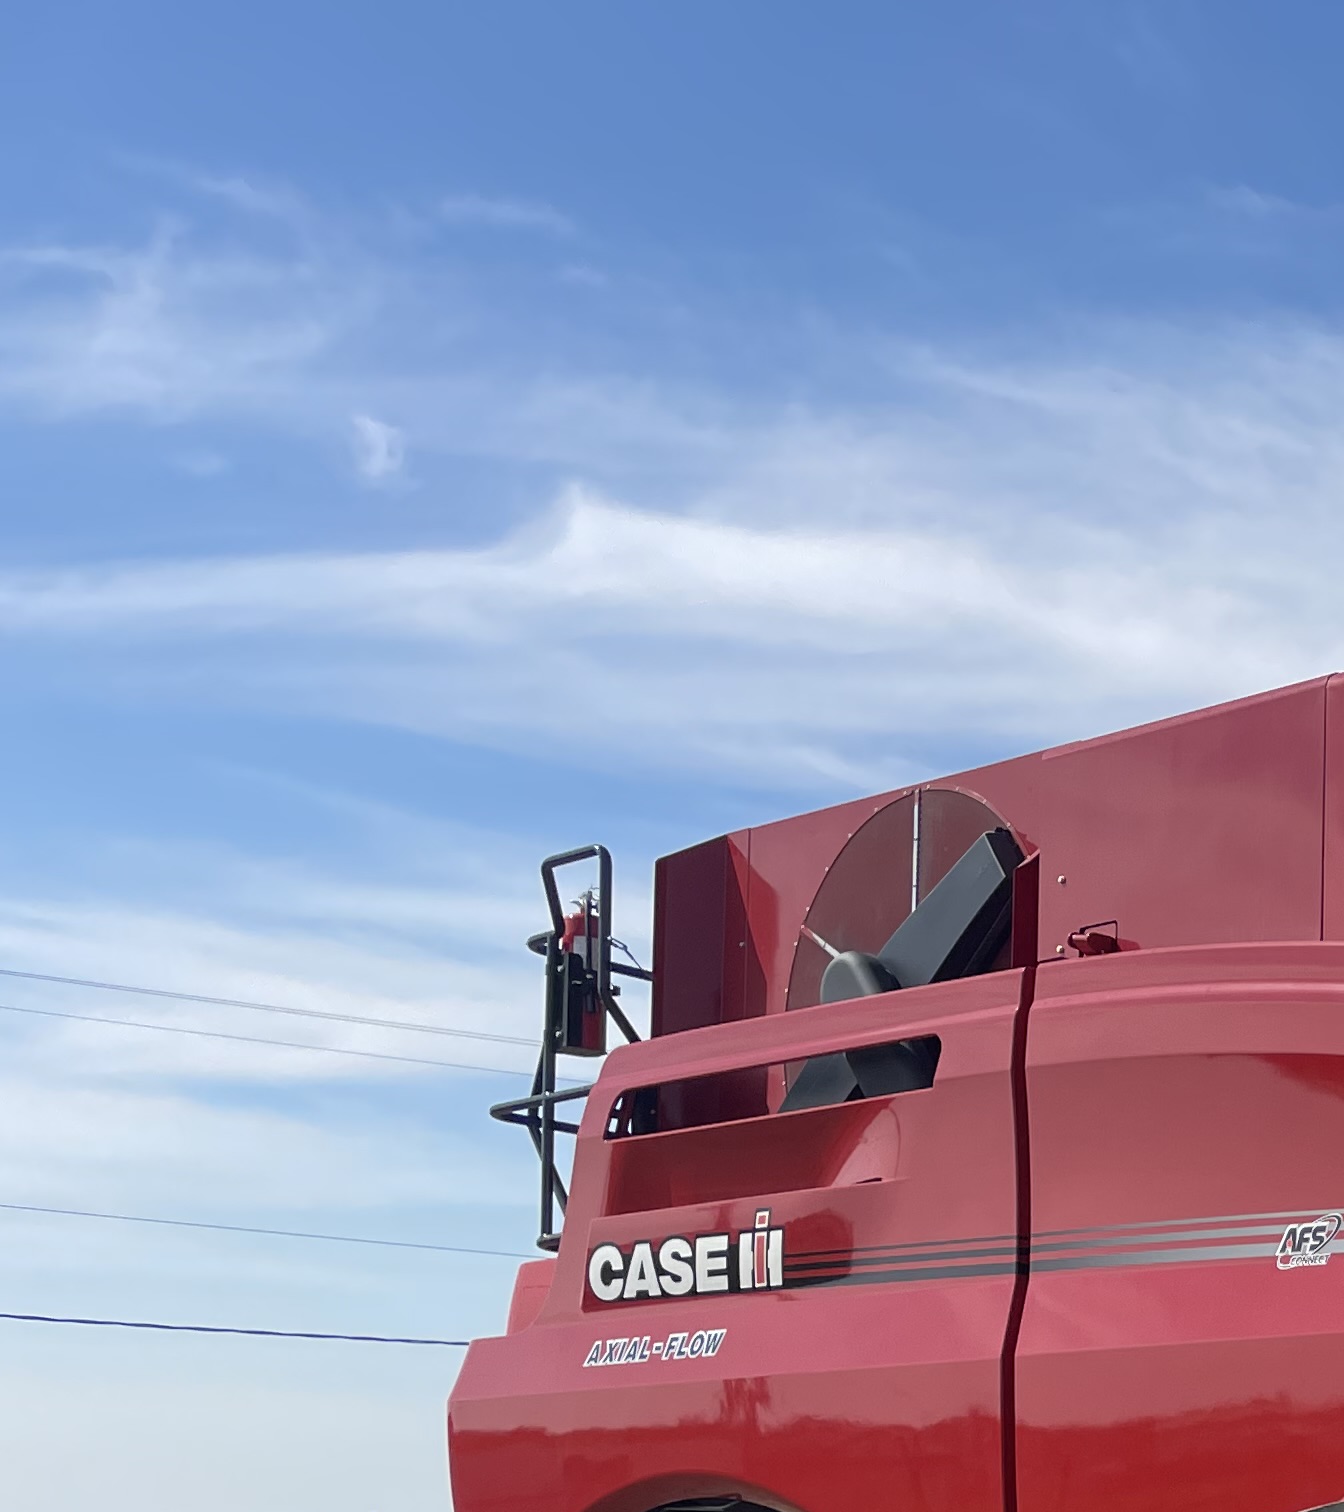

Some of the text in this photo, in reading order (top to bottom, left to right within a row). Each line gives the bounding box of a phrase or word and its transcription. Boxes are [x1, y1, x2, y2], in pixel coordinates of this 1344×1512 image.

[1277, 1223, 1330, 1255] AFS
[588, 1236, 730, 1301] CASE
[582, 1328, 728, 1368] AXIAL-FLOW
